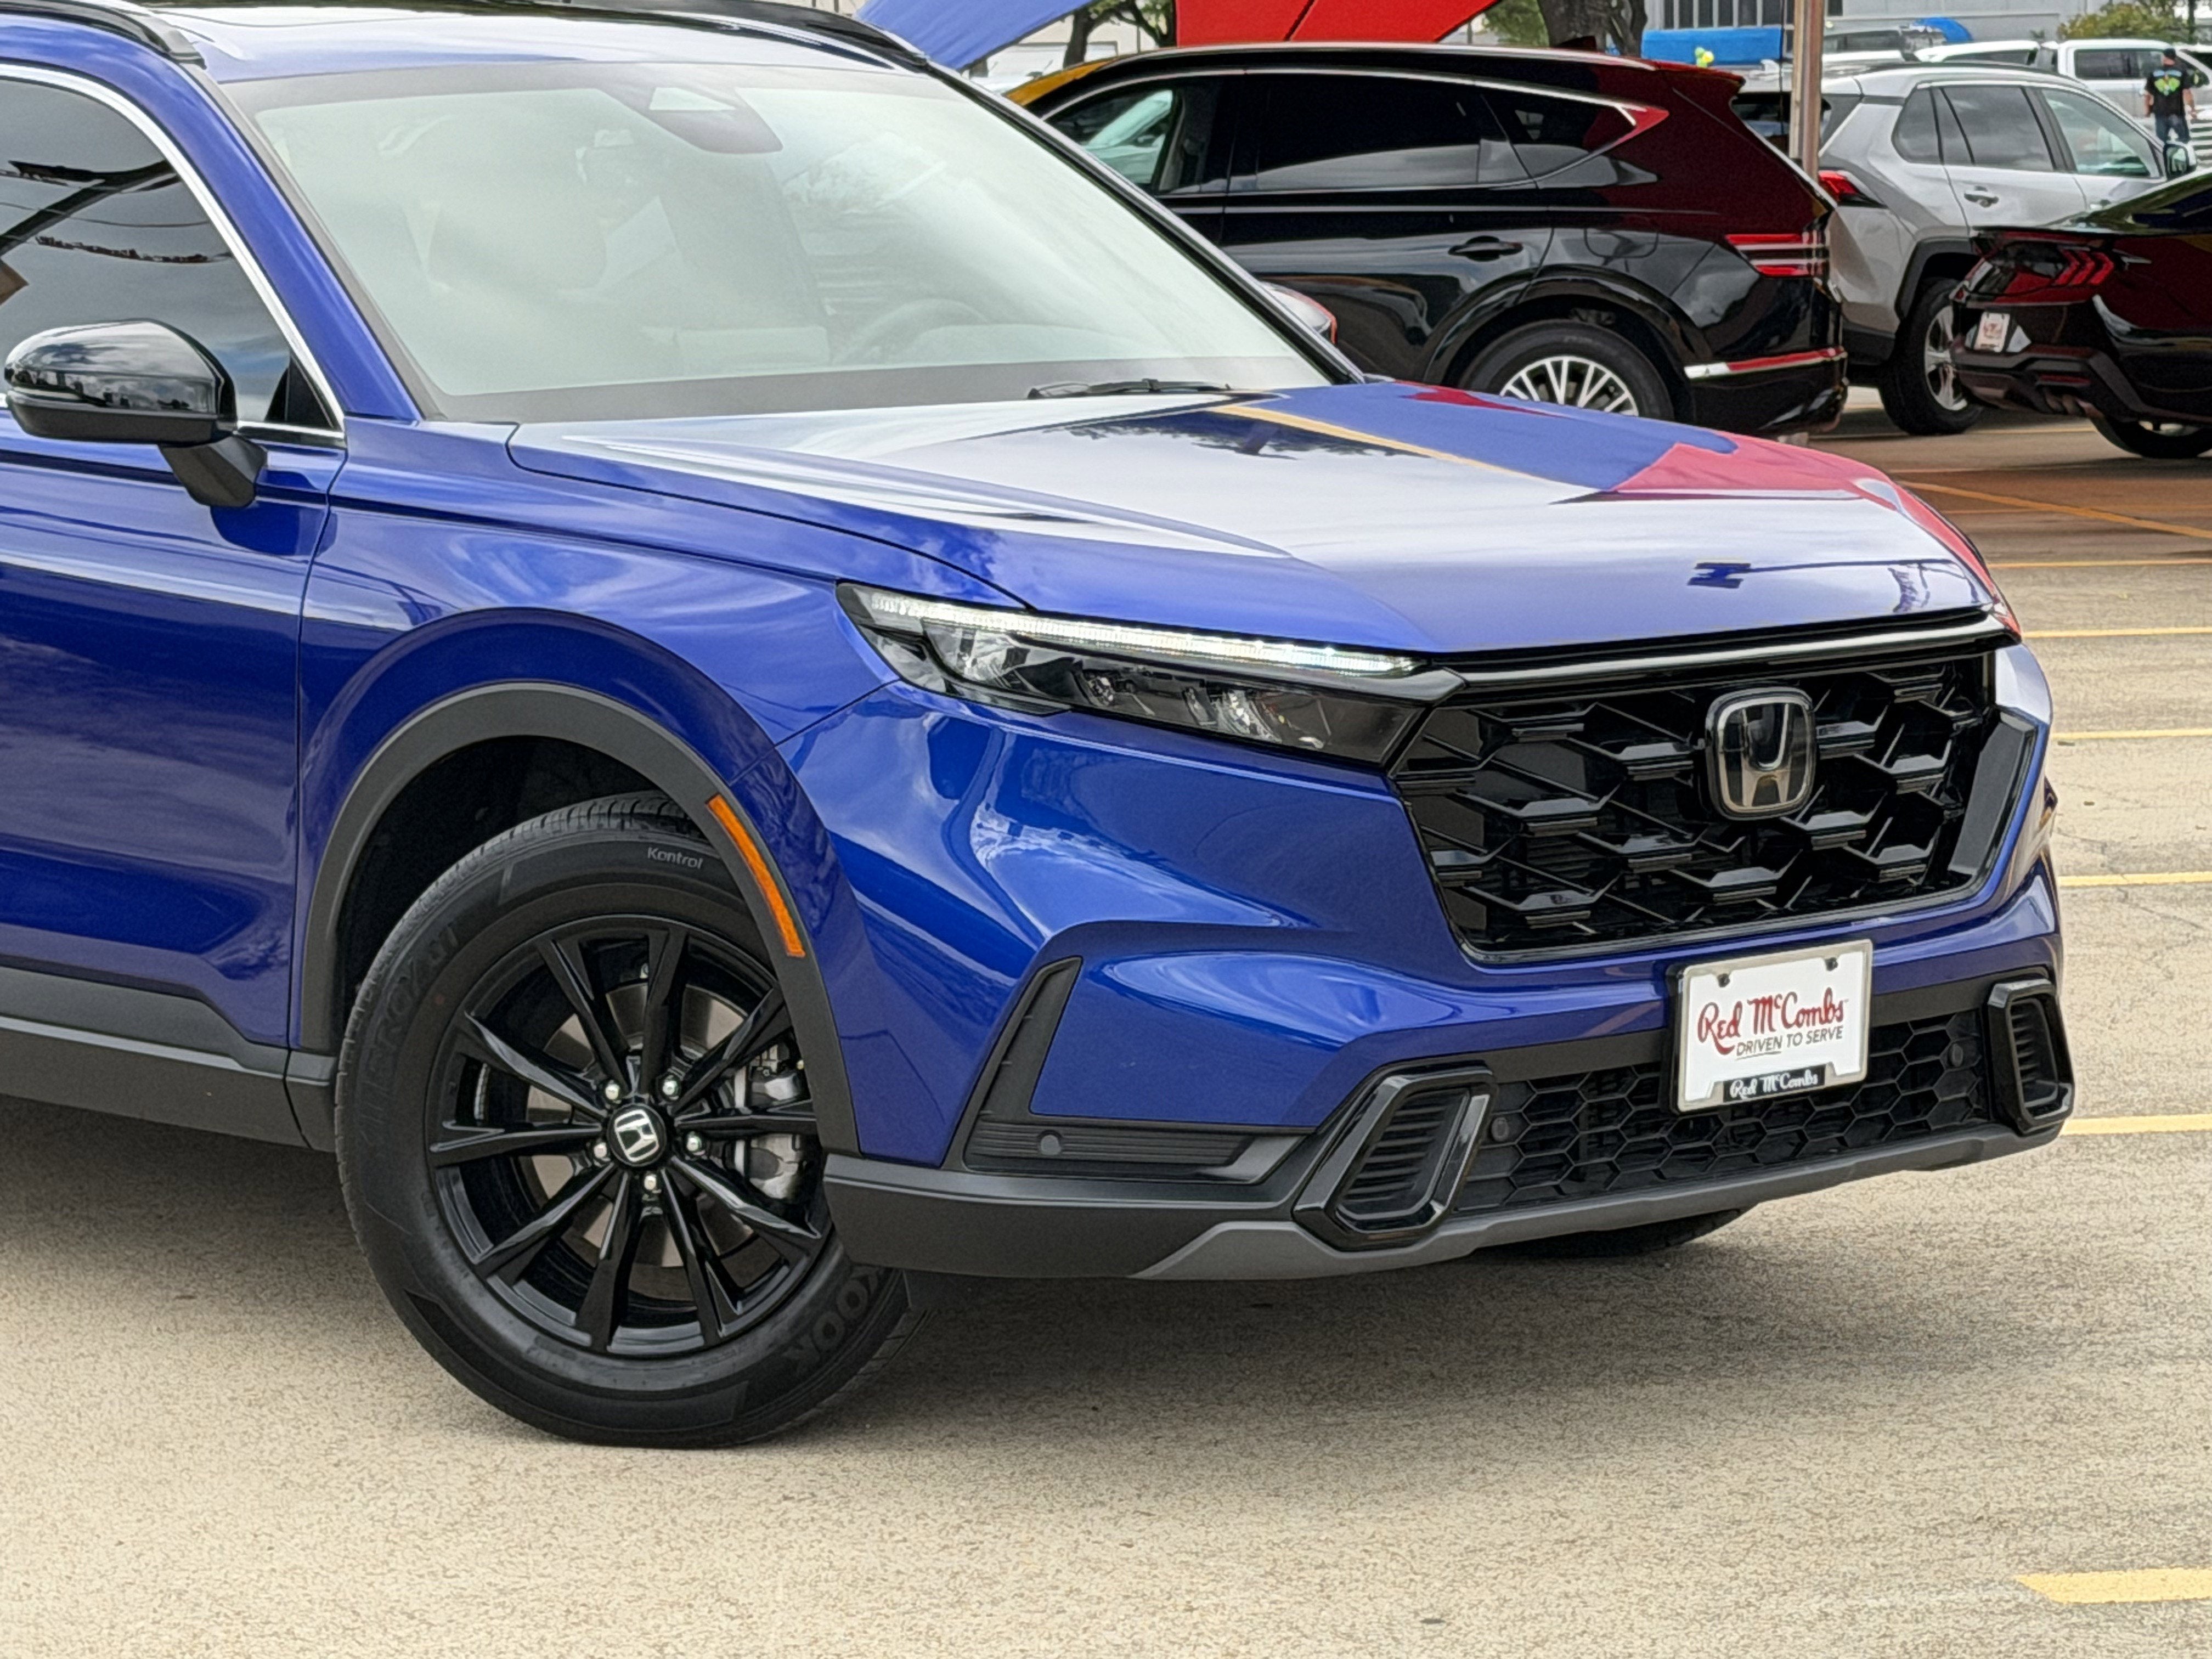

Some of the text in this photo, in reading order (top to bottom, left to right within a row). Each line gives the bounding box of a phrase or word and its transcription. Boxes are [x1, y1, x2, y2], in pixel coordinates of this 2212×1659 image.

[647, 847, 703, 869] Kontrol
[1697, 987, 1844, 1055] Red McCombs
[1736, 1025, 1843, 1057] DRIVEN TO SERVE
[1730, 1069, 1819, 1099] Red McCombs
